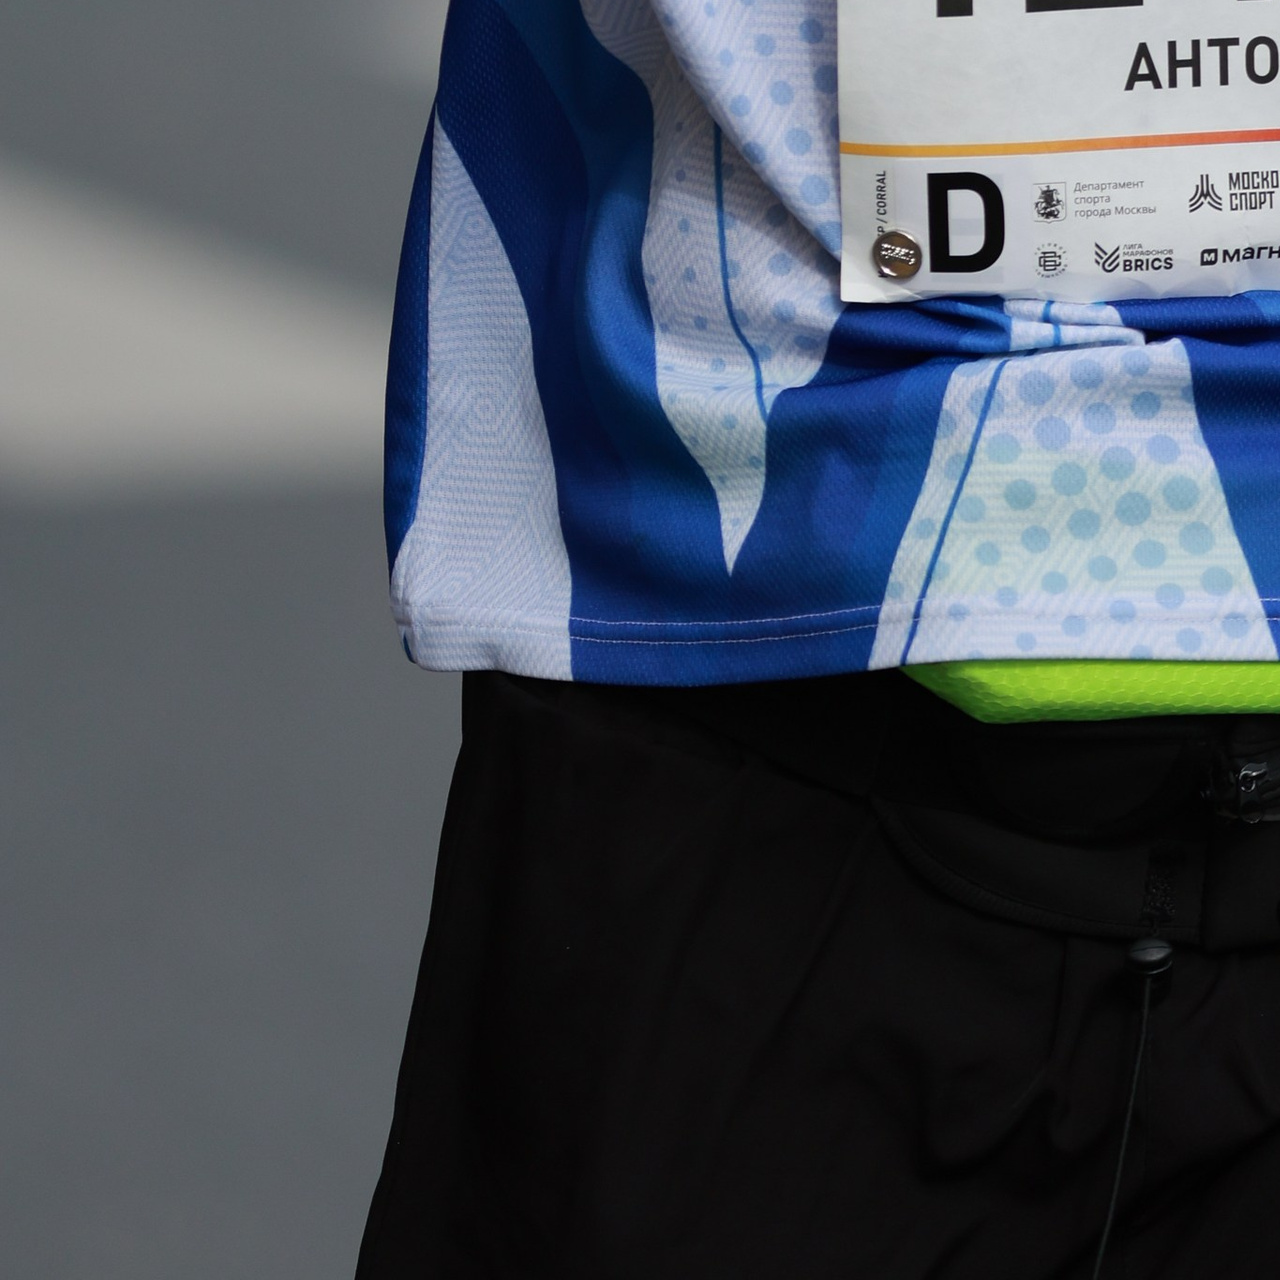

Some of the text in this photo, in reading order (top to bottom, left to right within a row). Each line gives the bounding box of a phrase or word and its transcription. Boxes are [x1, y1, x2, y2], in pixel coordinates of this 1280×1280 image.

[876, 170, 888, 216] CORRAL
[1073, 180, 1144, 193] Департамент
[1074, 194, 1111, 206] спорта
[1229, 191, 1275, 211] СПОРТ
[1074, 205, 1157, 218] города Москвы
[927, 171, 1006, 273] D
[1122, 249, 1174, 257] МАРАФОНОВ
[1122, 256, 1174, 272] BRICS
